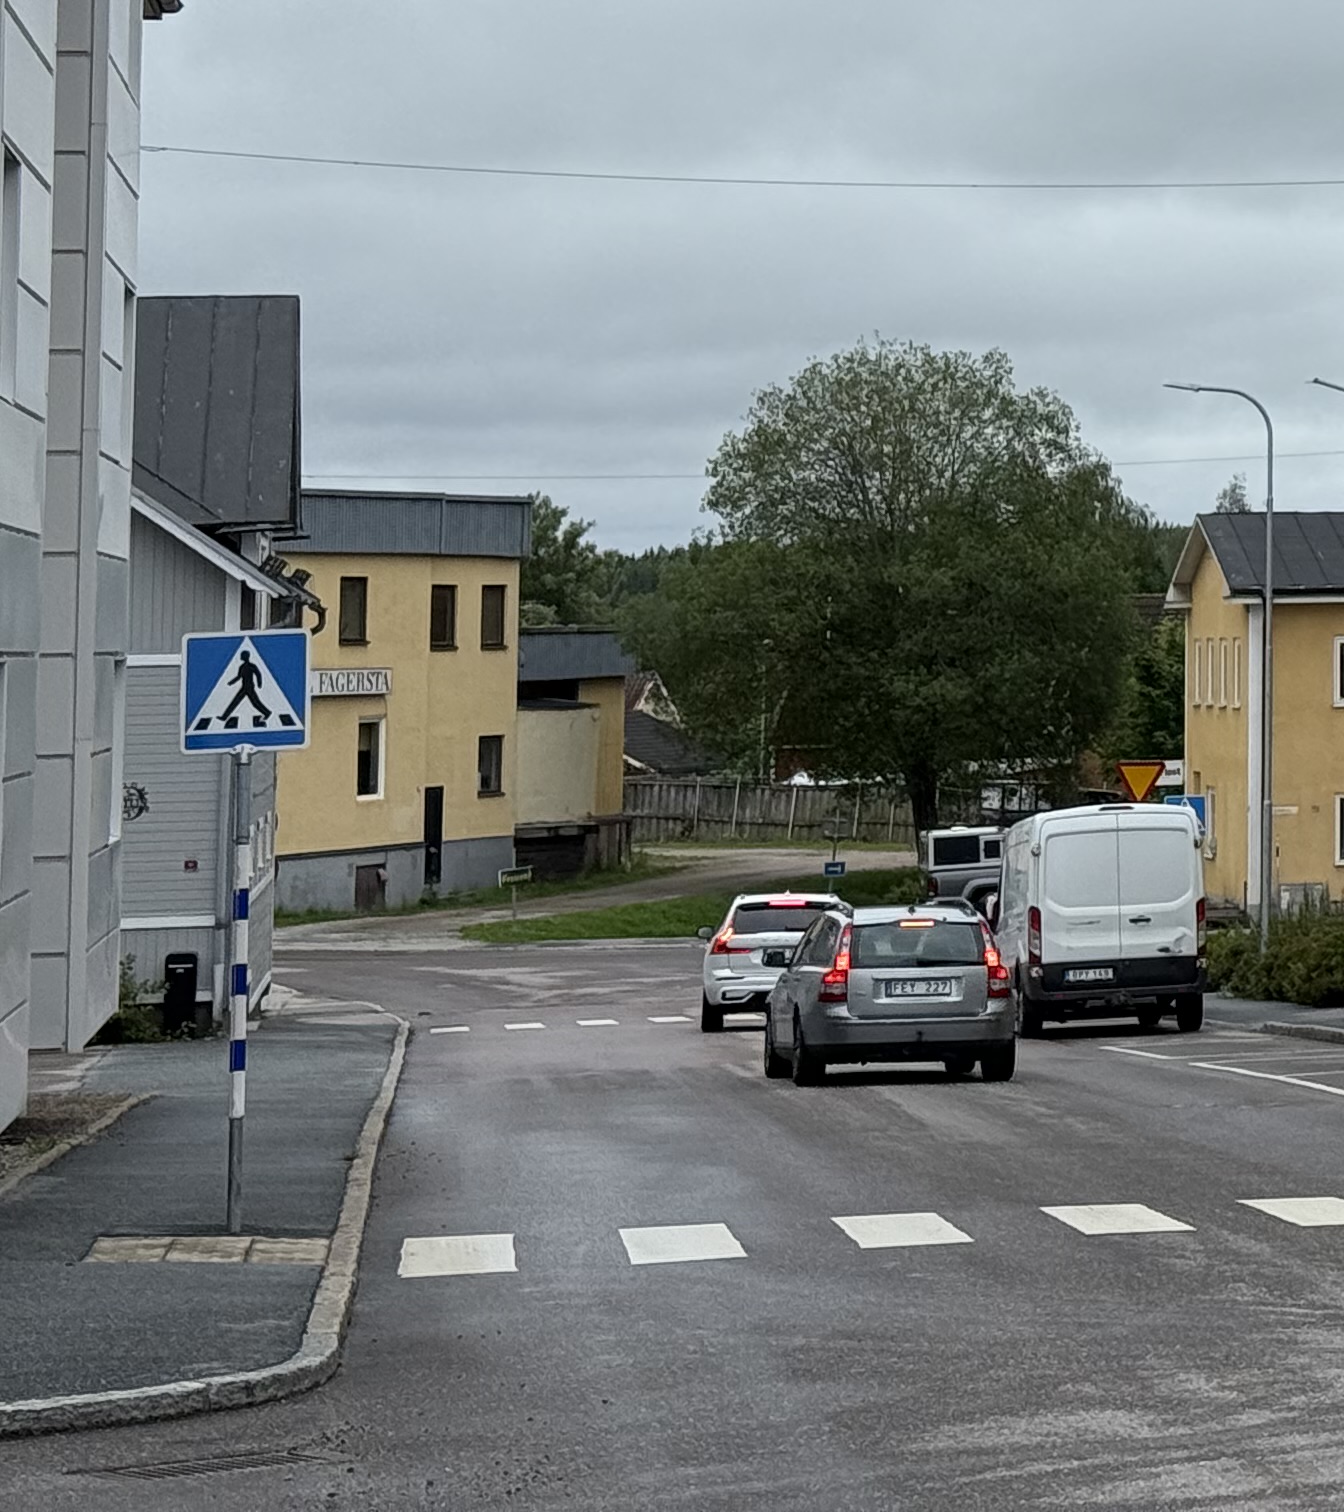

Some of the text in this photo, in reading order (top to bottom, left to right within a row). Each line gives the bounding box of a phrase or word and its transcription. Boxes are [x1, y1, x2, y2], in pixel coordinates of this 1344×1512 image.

[319, 671, 390, 694] FAGERSTA
[893, 981, 949, 994] FEY 227
